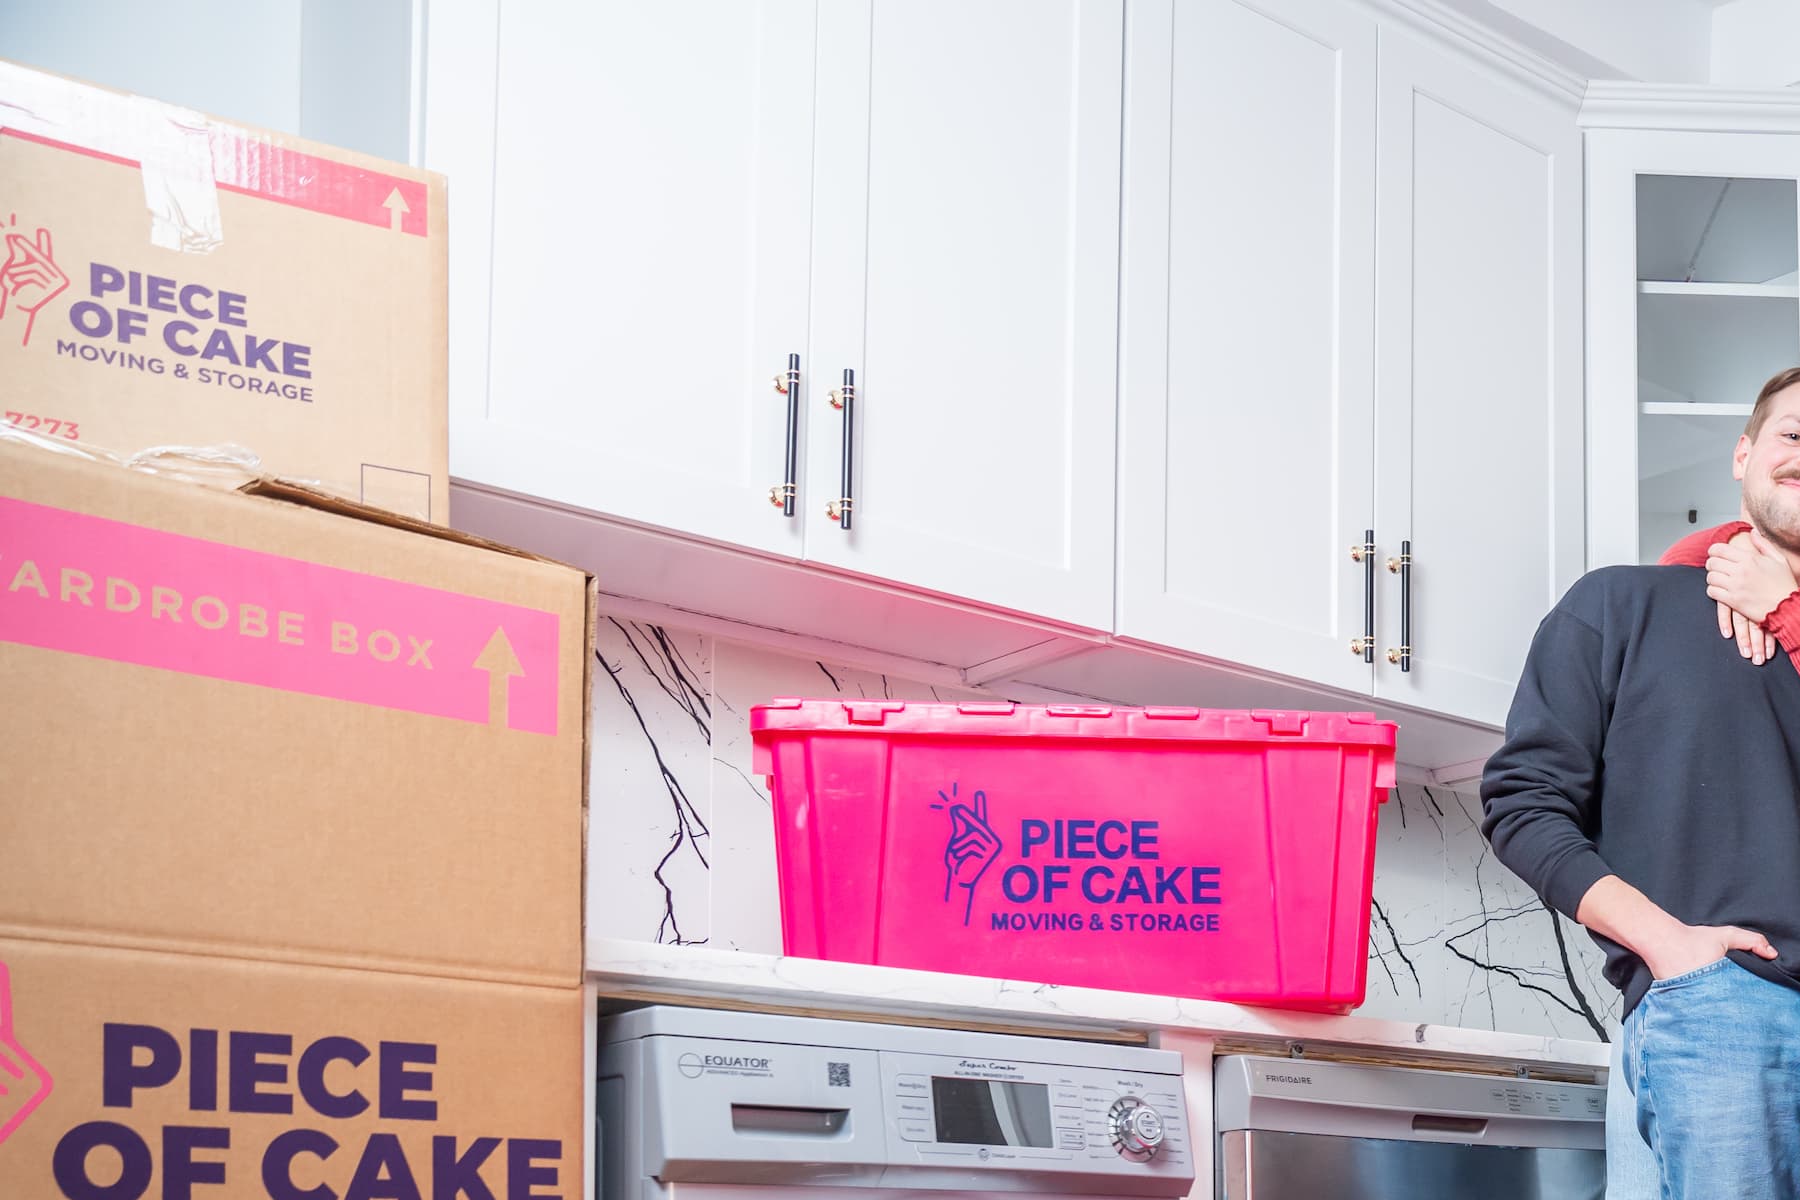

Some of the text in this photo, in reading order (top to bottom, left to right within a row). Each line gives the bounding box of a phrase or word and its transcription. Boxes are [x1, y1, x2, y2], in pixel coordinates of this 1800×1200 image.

[90, 262, 248, 328] PIECE
[69, 301, 312, 379] OF CAKE
[57, 340, 314, 403] MOVING & STORAGE
[0, 555, 435, 671] ARDROBE BOX
[1021, 819, 1159, 860] PIECE
[1002, 865, 1221, 905] OF CAKE
[991, 913, 1220, 932] MOVING & STORAGE
[103, 1022, 437, 1120] PIECE
[704, 1055, 768, 1069] EQUATOR
[1265, 1075, 1312, 1085] FRIGIDAIRE
